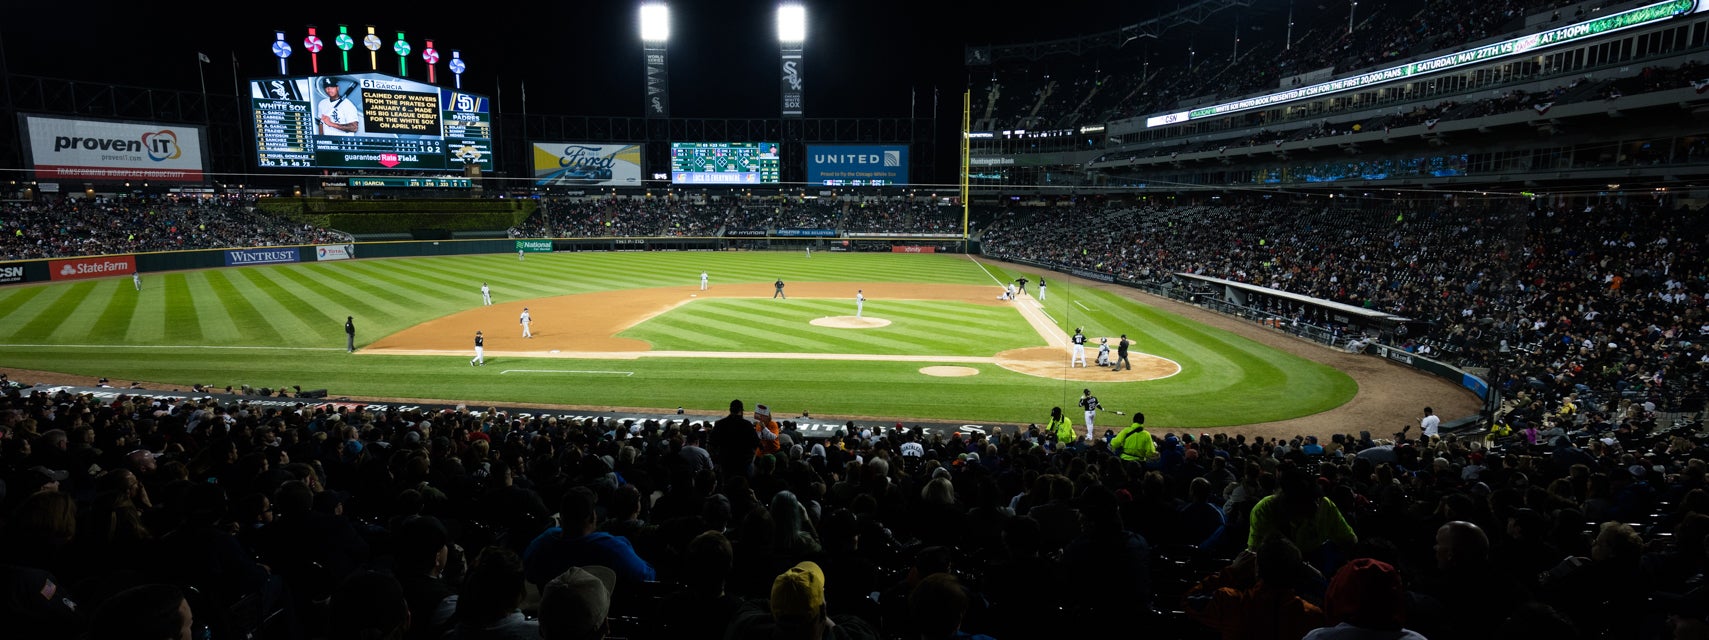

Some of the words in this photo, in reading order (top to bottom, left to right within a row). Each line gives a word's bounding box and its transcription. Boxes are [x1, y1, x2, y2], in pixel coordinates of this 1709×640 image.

[1418, 56, 1456, 72] SATURDAY,
[1458, 52, 1475, 62] MAY
[1477, 46, 1498, 59] 27TH
[1500, 42, 1512, 52] VS
[1541, 33, 1554, 43] AT
[1556, 23, 1590, 40] 1:10PM
[1270, 91, 1297, 102] PRESENTED
[1343, 78, 1360, 87] FIRST
[1361, 72, 1382, 84] 20,000
[1384, 69, 1402, 79] FANS
[54, 136, 141, 152] proven
[152, 139, 170, 153] IT
[559, 146, 616, 168] Ford
[815, 155, 879, 164] UNITED
[57, 168, 105, 176] TRANSFORMING
[230, 251, 293, 262] WINTRUST
